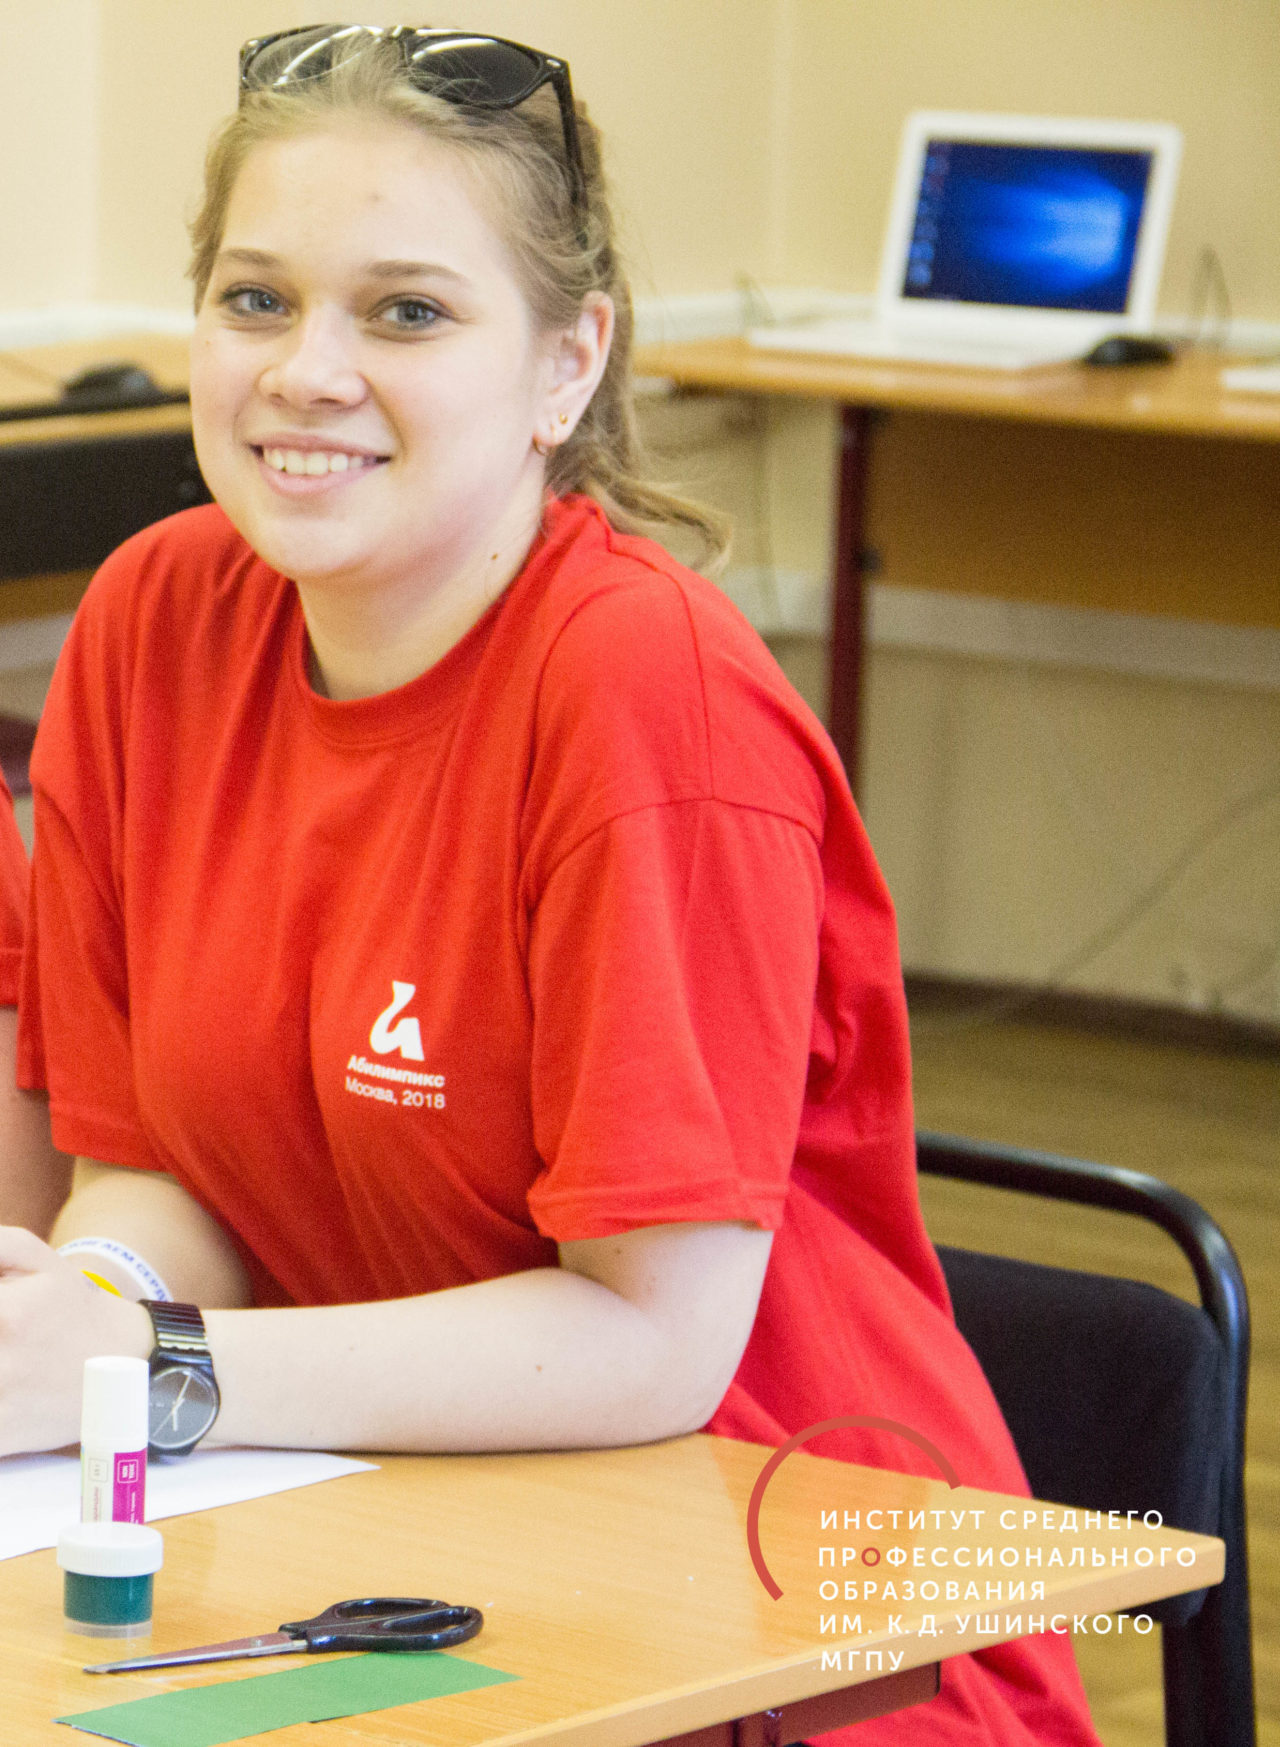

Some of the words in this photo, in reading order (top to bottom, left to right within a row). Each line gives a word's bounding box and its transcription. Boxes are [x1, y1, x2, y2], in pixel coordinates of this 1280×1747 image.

[347, 1054, 446, 1088] Абилимпикс
[345, 1076, 398, 1106] Москва,
[402, 1089, 446, 1110] 2018
